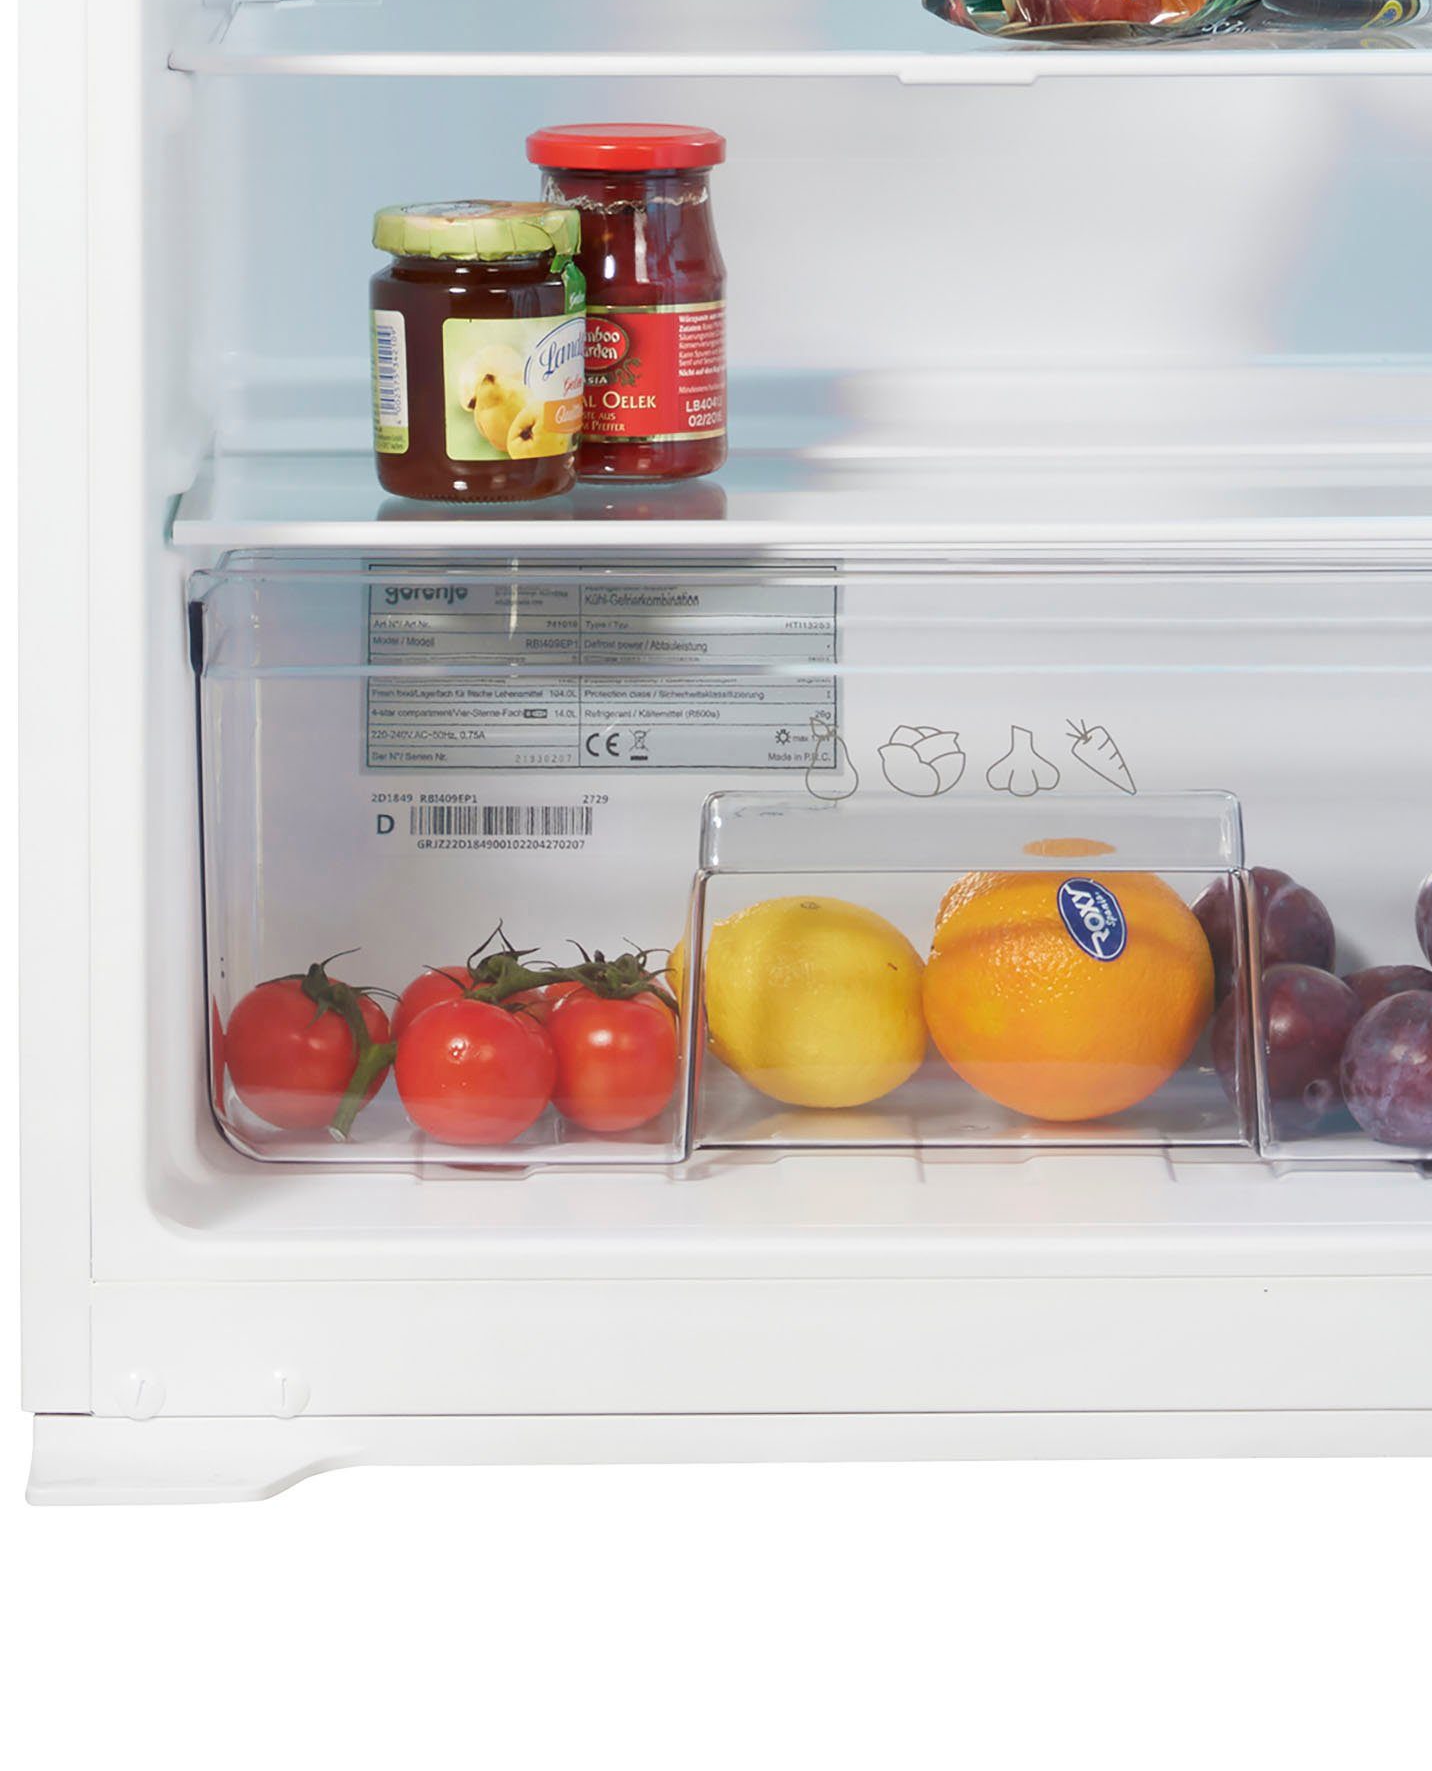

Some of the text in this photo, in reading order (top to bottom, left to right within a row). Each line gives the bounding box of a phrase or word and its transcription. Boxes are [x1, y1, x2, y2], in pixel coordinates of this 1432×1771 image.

[586, 326, 620, 344] mboo
[602, 391, 656, 410] OELEK
[768, 752, 791, 762] Made
[376, 813, 395, 835] D
[1063, 883, 1110, 958] ROXY
